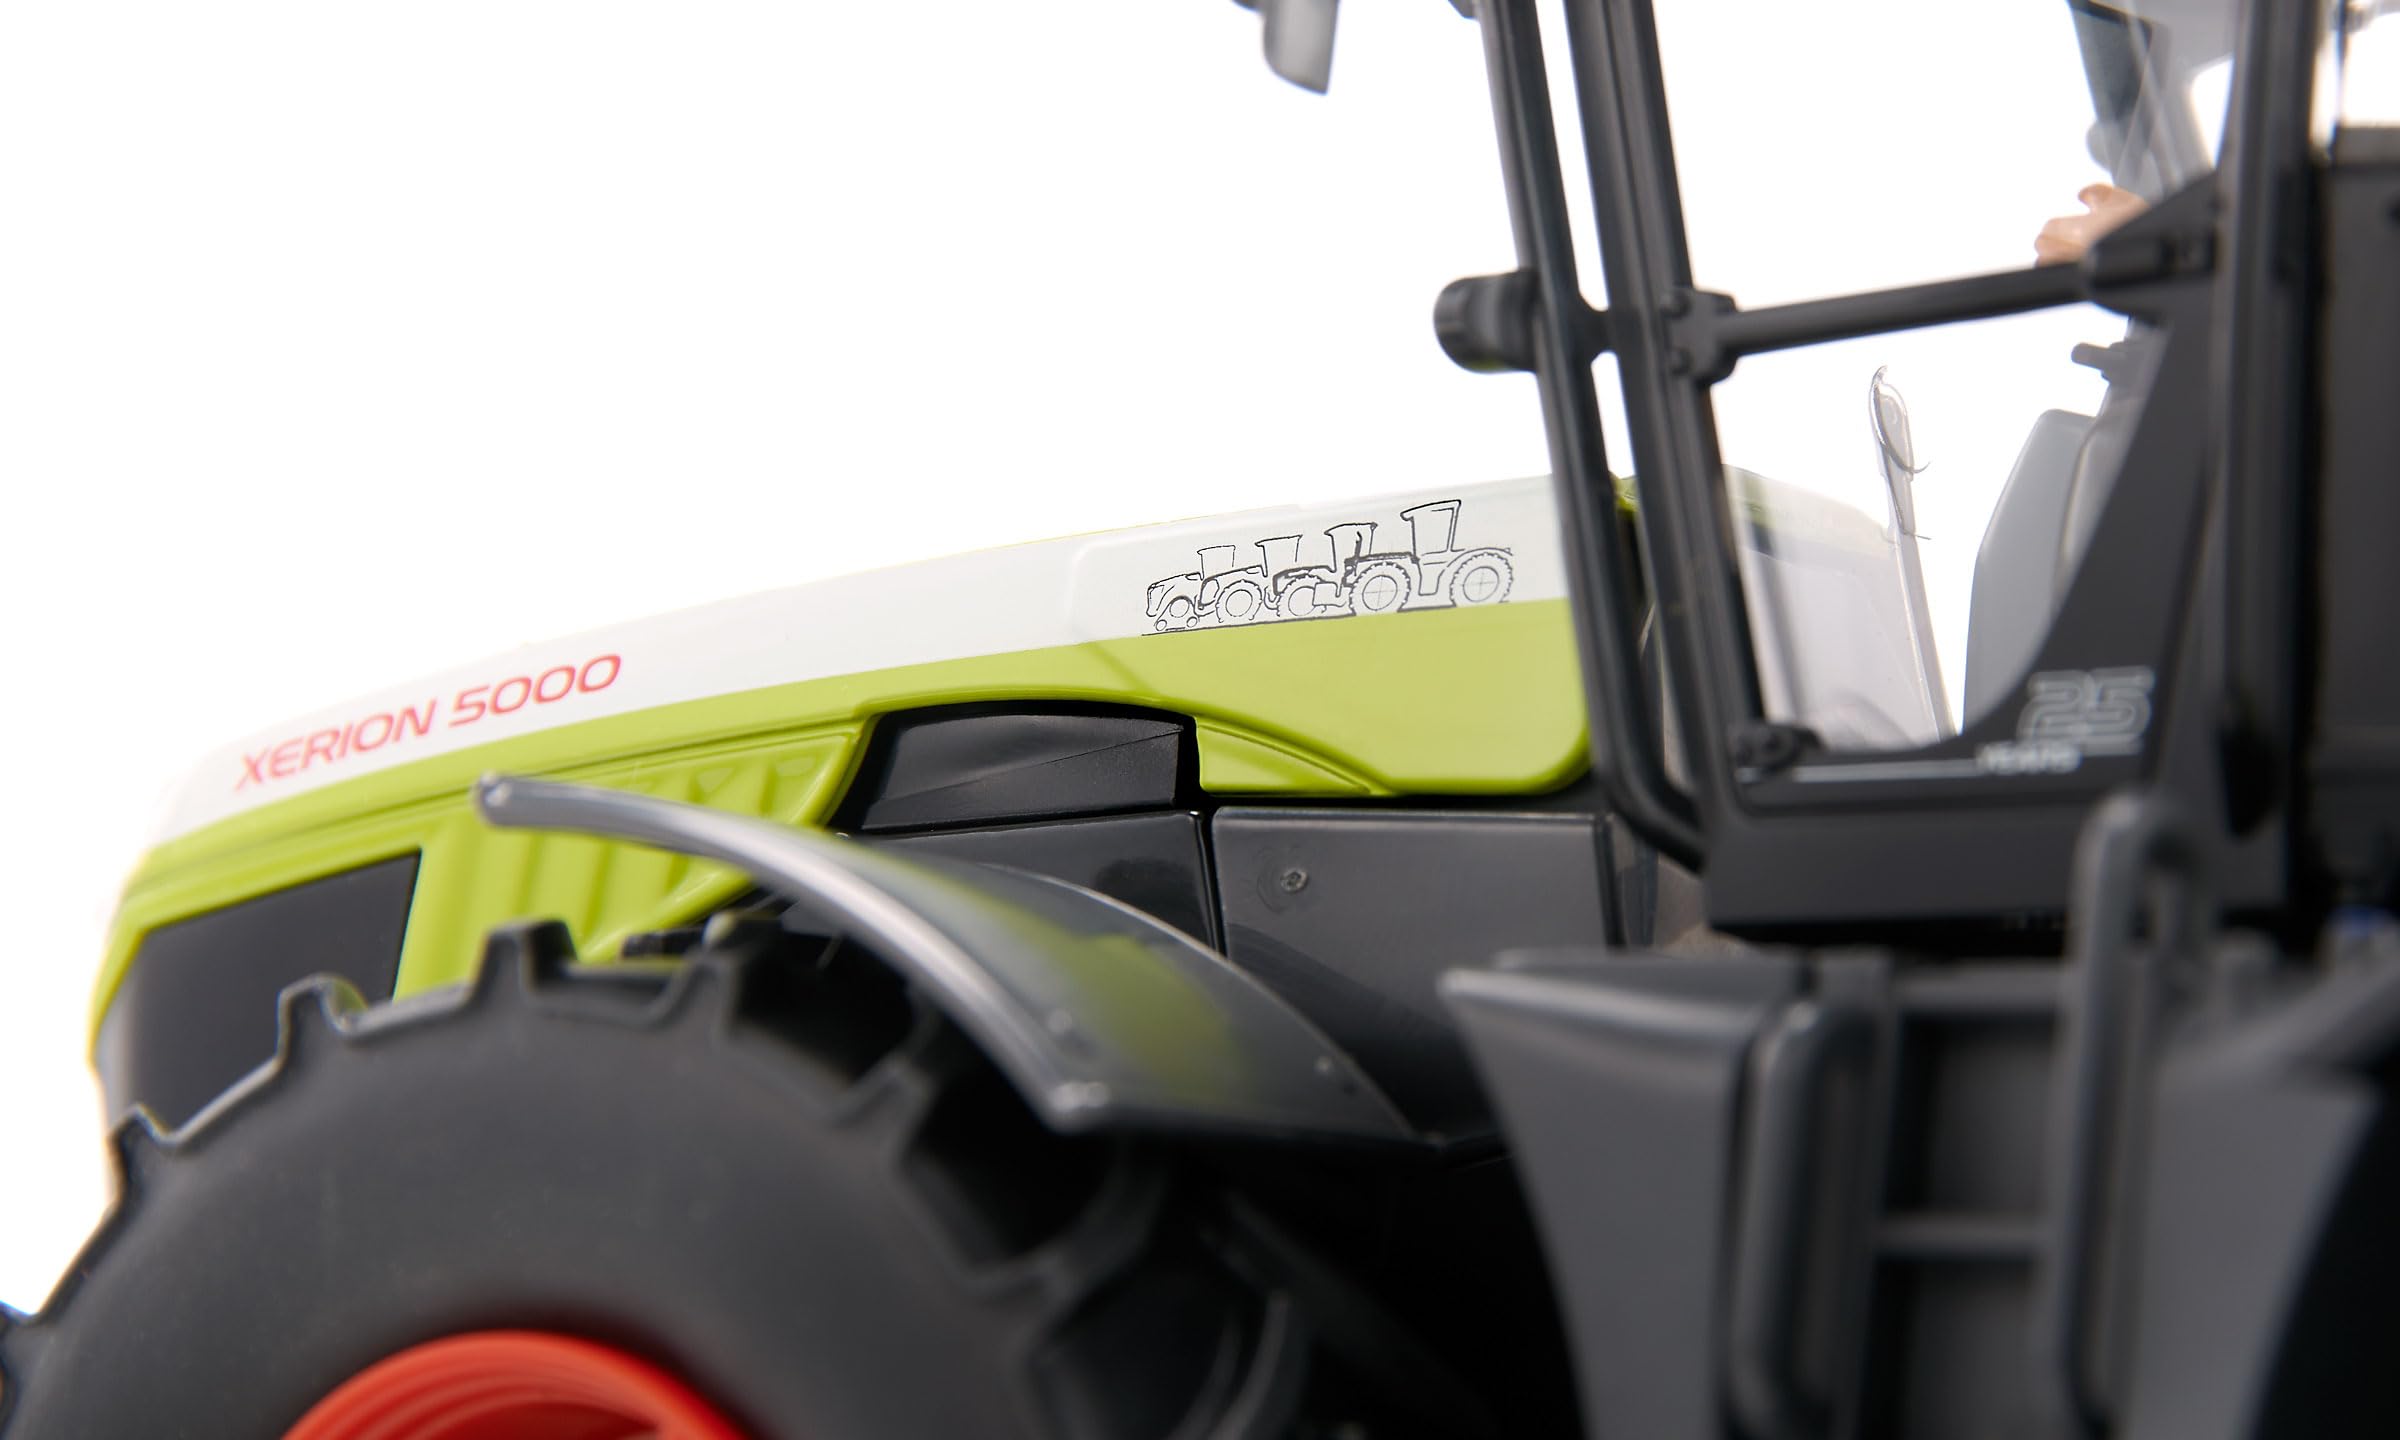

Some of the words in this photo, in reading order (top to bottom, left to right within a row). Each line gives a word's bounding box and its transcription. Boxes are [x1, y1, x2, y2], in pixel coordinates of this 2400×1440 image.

[235, 698, 437, 792] XERION
[448, 653, 622, 728] 5000
[2017, 666, 2155, 755] 25
